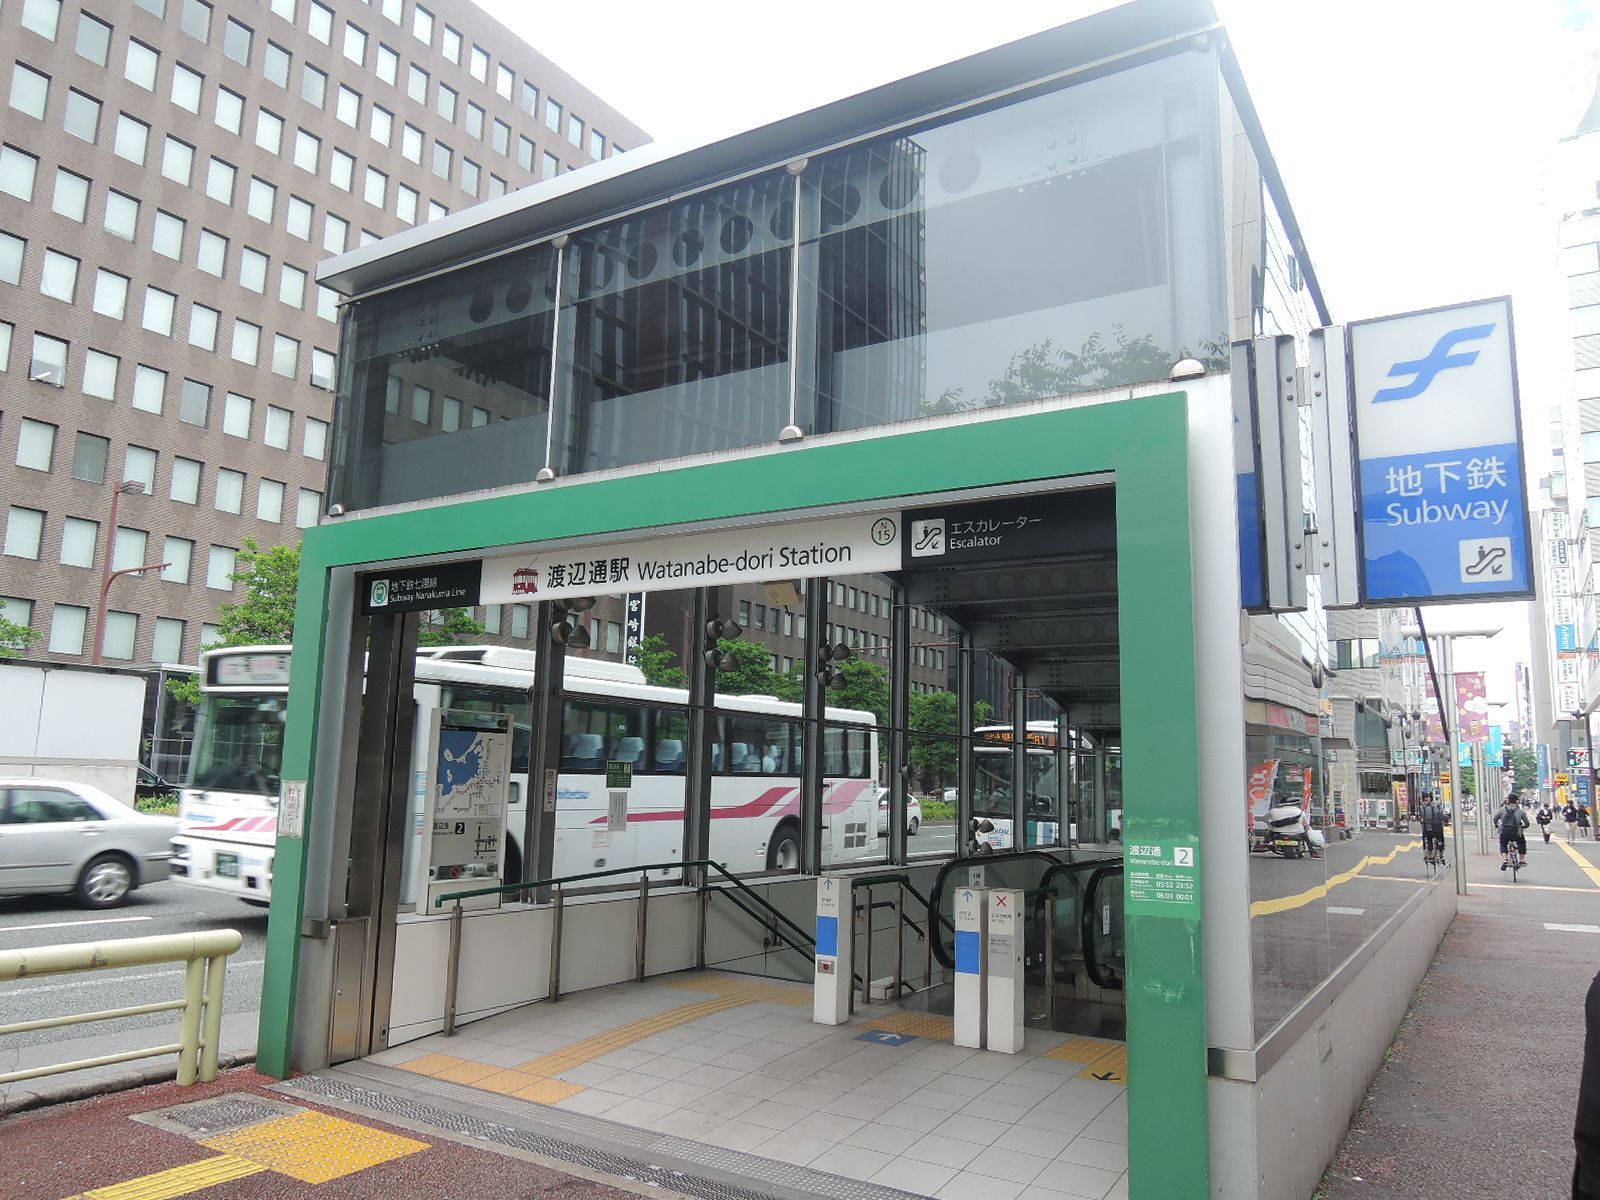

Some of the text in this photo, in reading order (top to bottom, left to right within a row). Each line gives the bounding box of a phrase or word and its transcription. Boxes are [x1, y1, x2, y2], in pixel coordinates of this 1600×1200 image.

[1385, 455, 1507, 497] 地下鉄
[1386, 498, 1509, 527] Subway
[880, 521, 887, 530] N
[950, 515, 1042, 535] エスカレーター
[877, 530, 890, 542] 15
[950, 535, 1002, 550] Escalator
[637, 542, 852, 581] Watanabe-dori Station
[546, 557, 630, 589] 渡辺通駅
[389, 588, 467, 603] Subway Nanakuma Line
[1130, 844, 1161, 857] 渡辺通
[1179, 849, 1189, 864] 2
[1155, 881, 1174, 889] 05:52
[1175, 881, 1194, 890] 23:52
